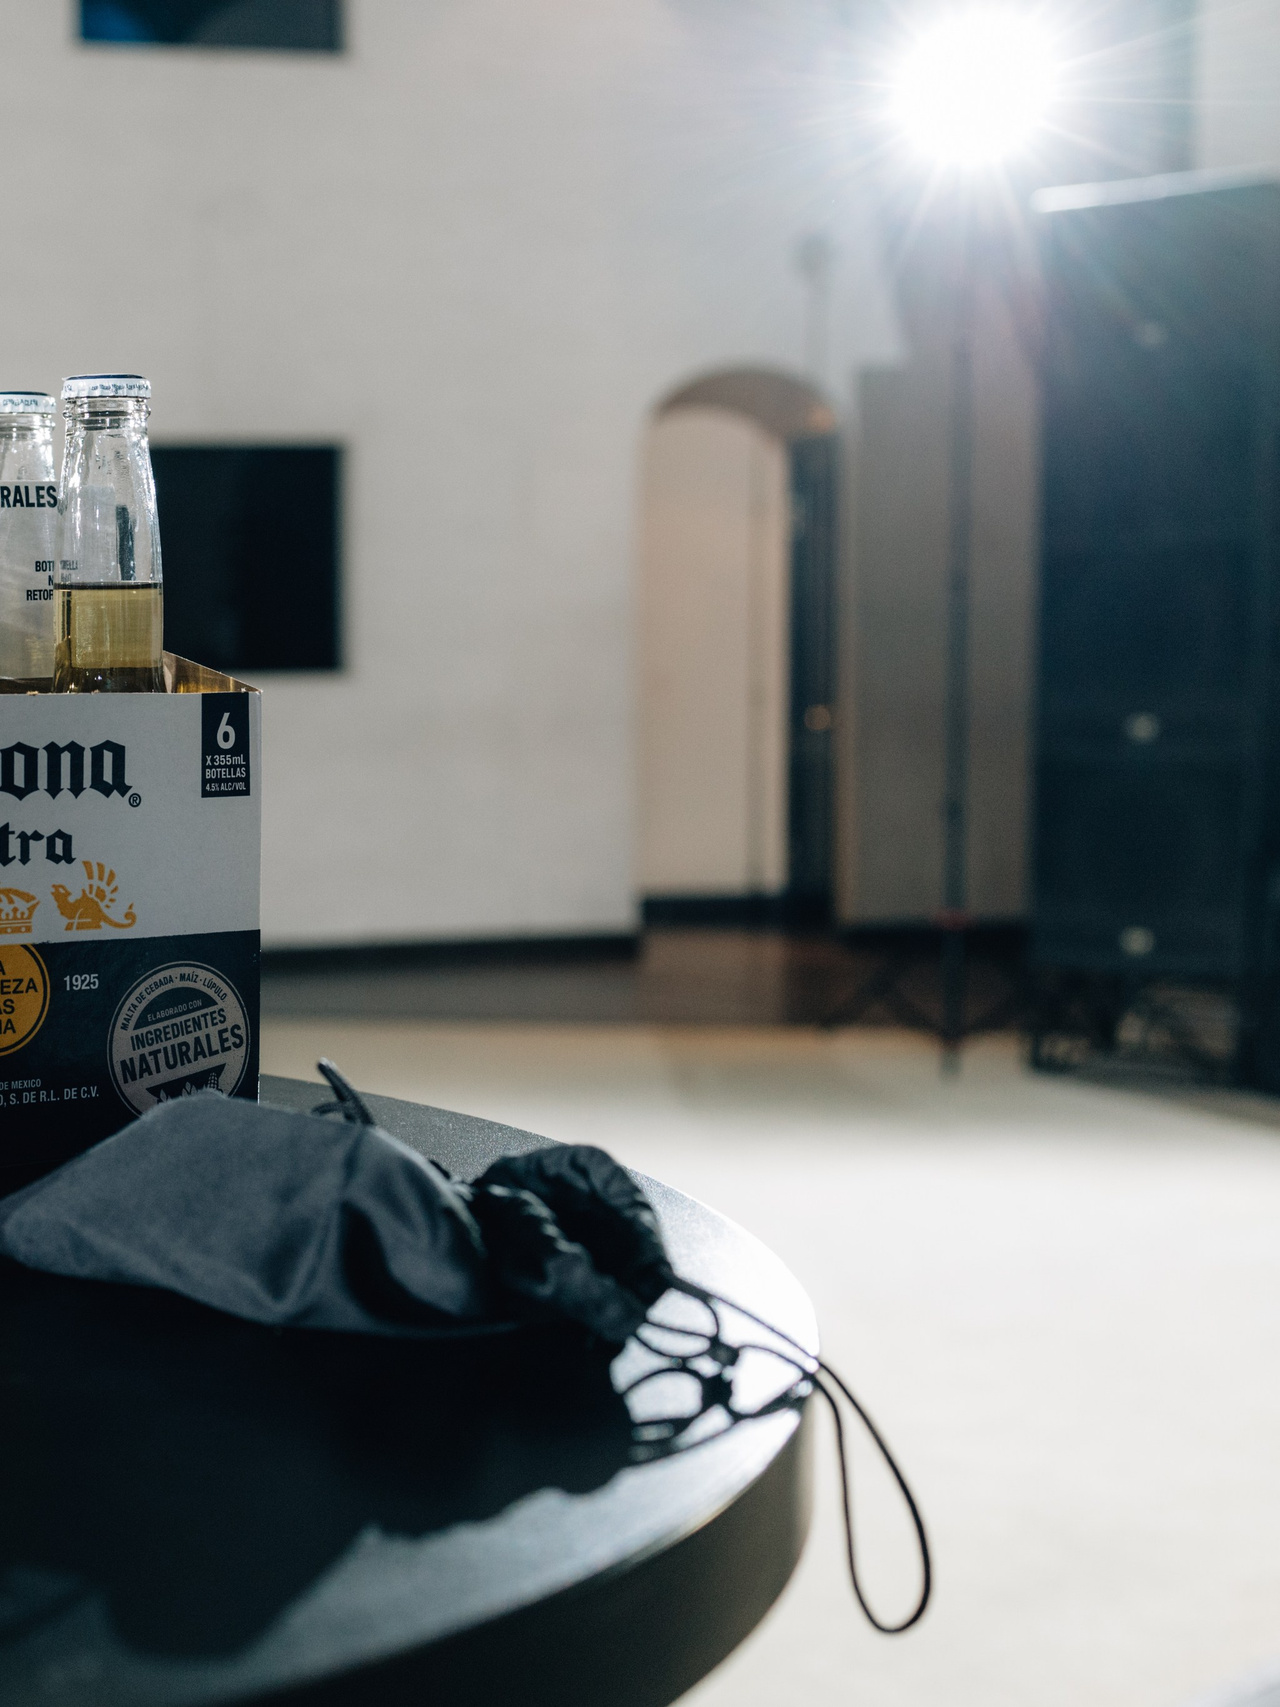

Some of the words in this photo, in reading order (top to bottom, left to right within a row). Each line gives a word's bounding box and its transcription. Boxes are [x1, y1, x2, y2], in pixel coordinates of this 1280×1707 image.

[216, 712, 236, 750] 6
[205, 755, 212, 766] X
[213, 753, 247, 766] 355mL
[205, 767, 247, 779] BOTELLAS
[205, 783, 220, 792] 4.5%
[220, 781, 247, 791] ALC/VOL
[63, 973, 100, 991] 1925
[120, 1003, 139, 1031] MALTA
[135, 991, 147, 1005] DE
[144, 974, 174, 996] CEBADA
[179, 970, 199, 984] MAÍZ
[147, 1003, 188, 1022] ELABORADO
[188, 999, 203, 1010] CON
[130, 1008, 227, 1052] INGREDIENTES
[120, 1023, 244, 1085] NATURALES
[11, 1078, 42, 1090] MEXICO
[9, 1091, 20, 1106] S.
[22, 1091, 38, 1104] DE
[39, 1088, 61, 1103] R.L.
[63, 1087, 78, 1101] DE
[80, 1085, 100, 1100] C.V.
